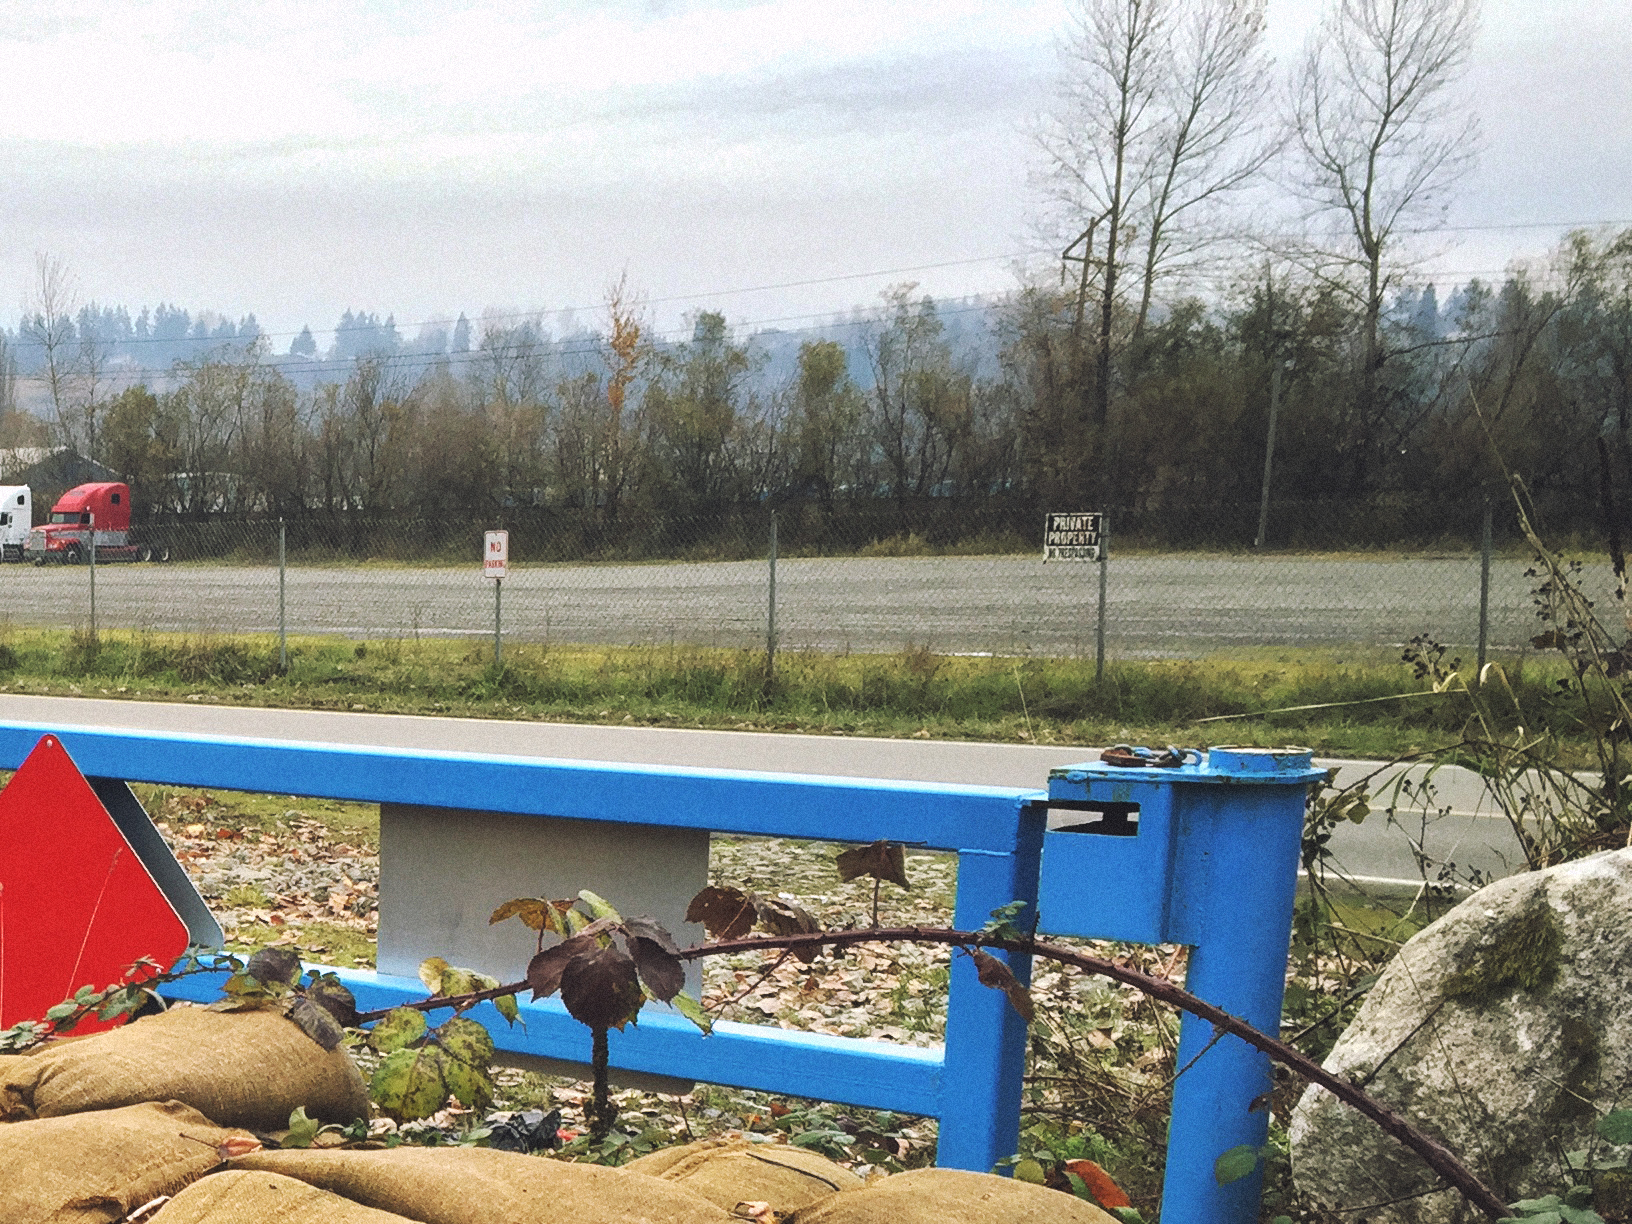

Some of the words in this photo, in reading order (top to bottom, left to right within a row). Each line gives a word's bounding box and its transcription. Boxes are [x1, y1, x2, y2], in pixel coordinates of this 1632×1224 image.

[1053, 516, 1094, 530] PRIVATE
[1048, 531, 1097, 545] PROPERTY
[490, 541, 501, 552] NO
